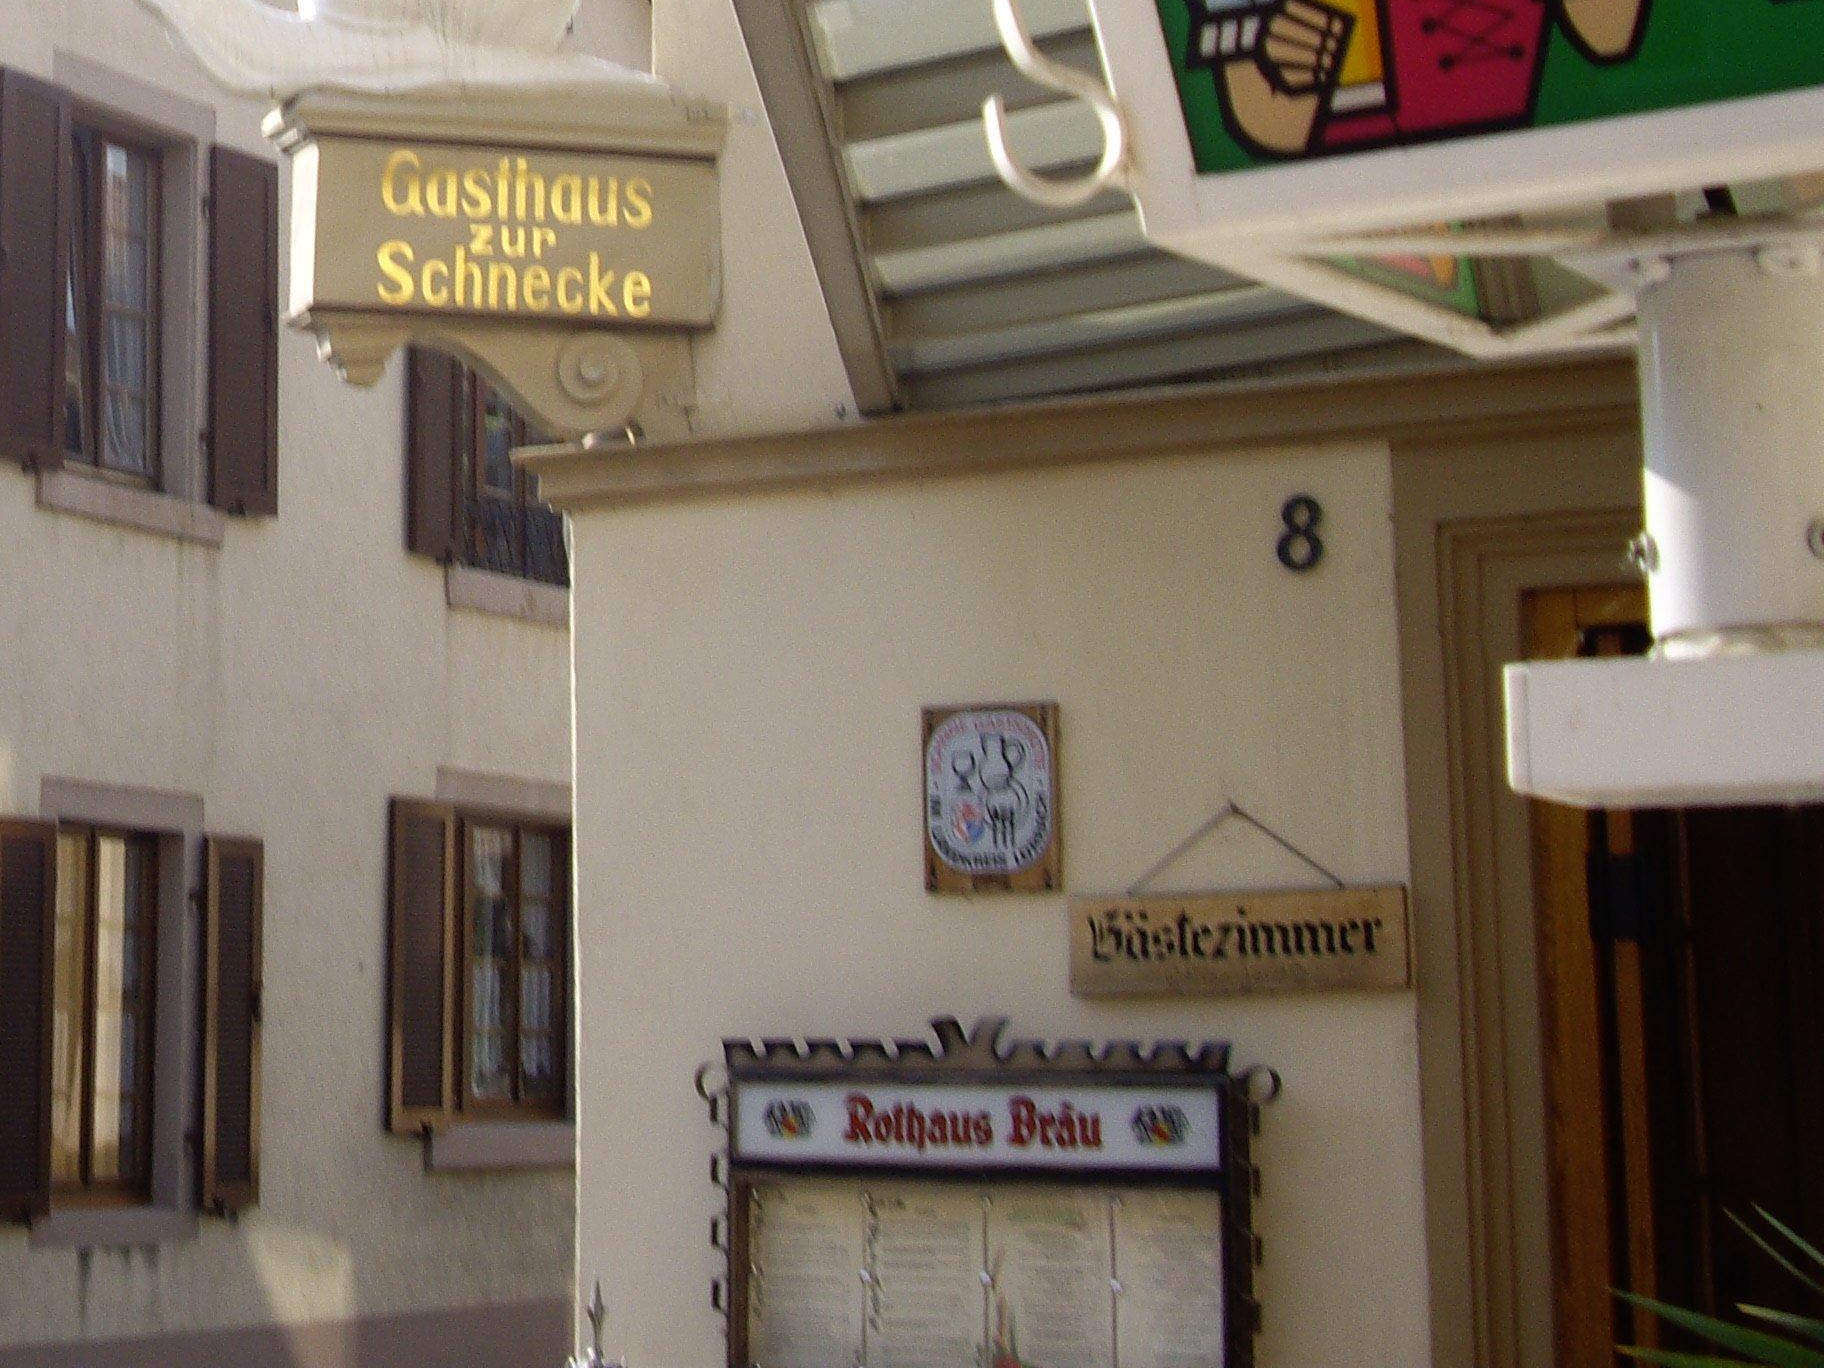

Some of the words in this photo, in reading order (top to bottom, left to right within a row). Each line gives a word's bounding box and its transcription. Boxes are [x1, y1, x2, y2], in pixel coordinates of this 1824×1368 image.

[380, 149, 653, 230] Gasthaus
[375, 239, 653, 318] Schnecke
[469, 223, 558, 260] zur
[1277, 494, 1324, 573] 8
[843, 1091, 994, 1153] Rothaus
[1007, 1095, 1104, 1151] Bräu
